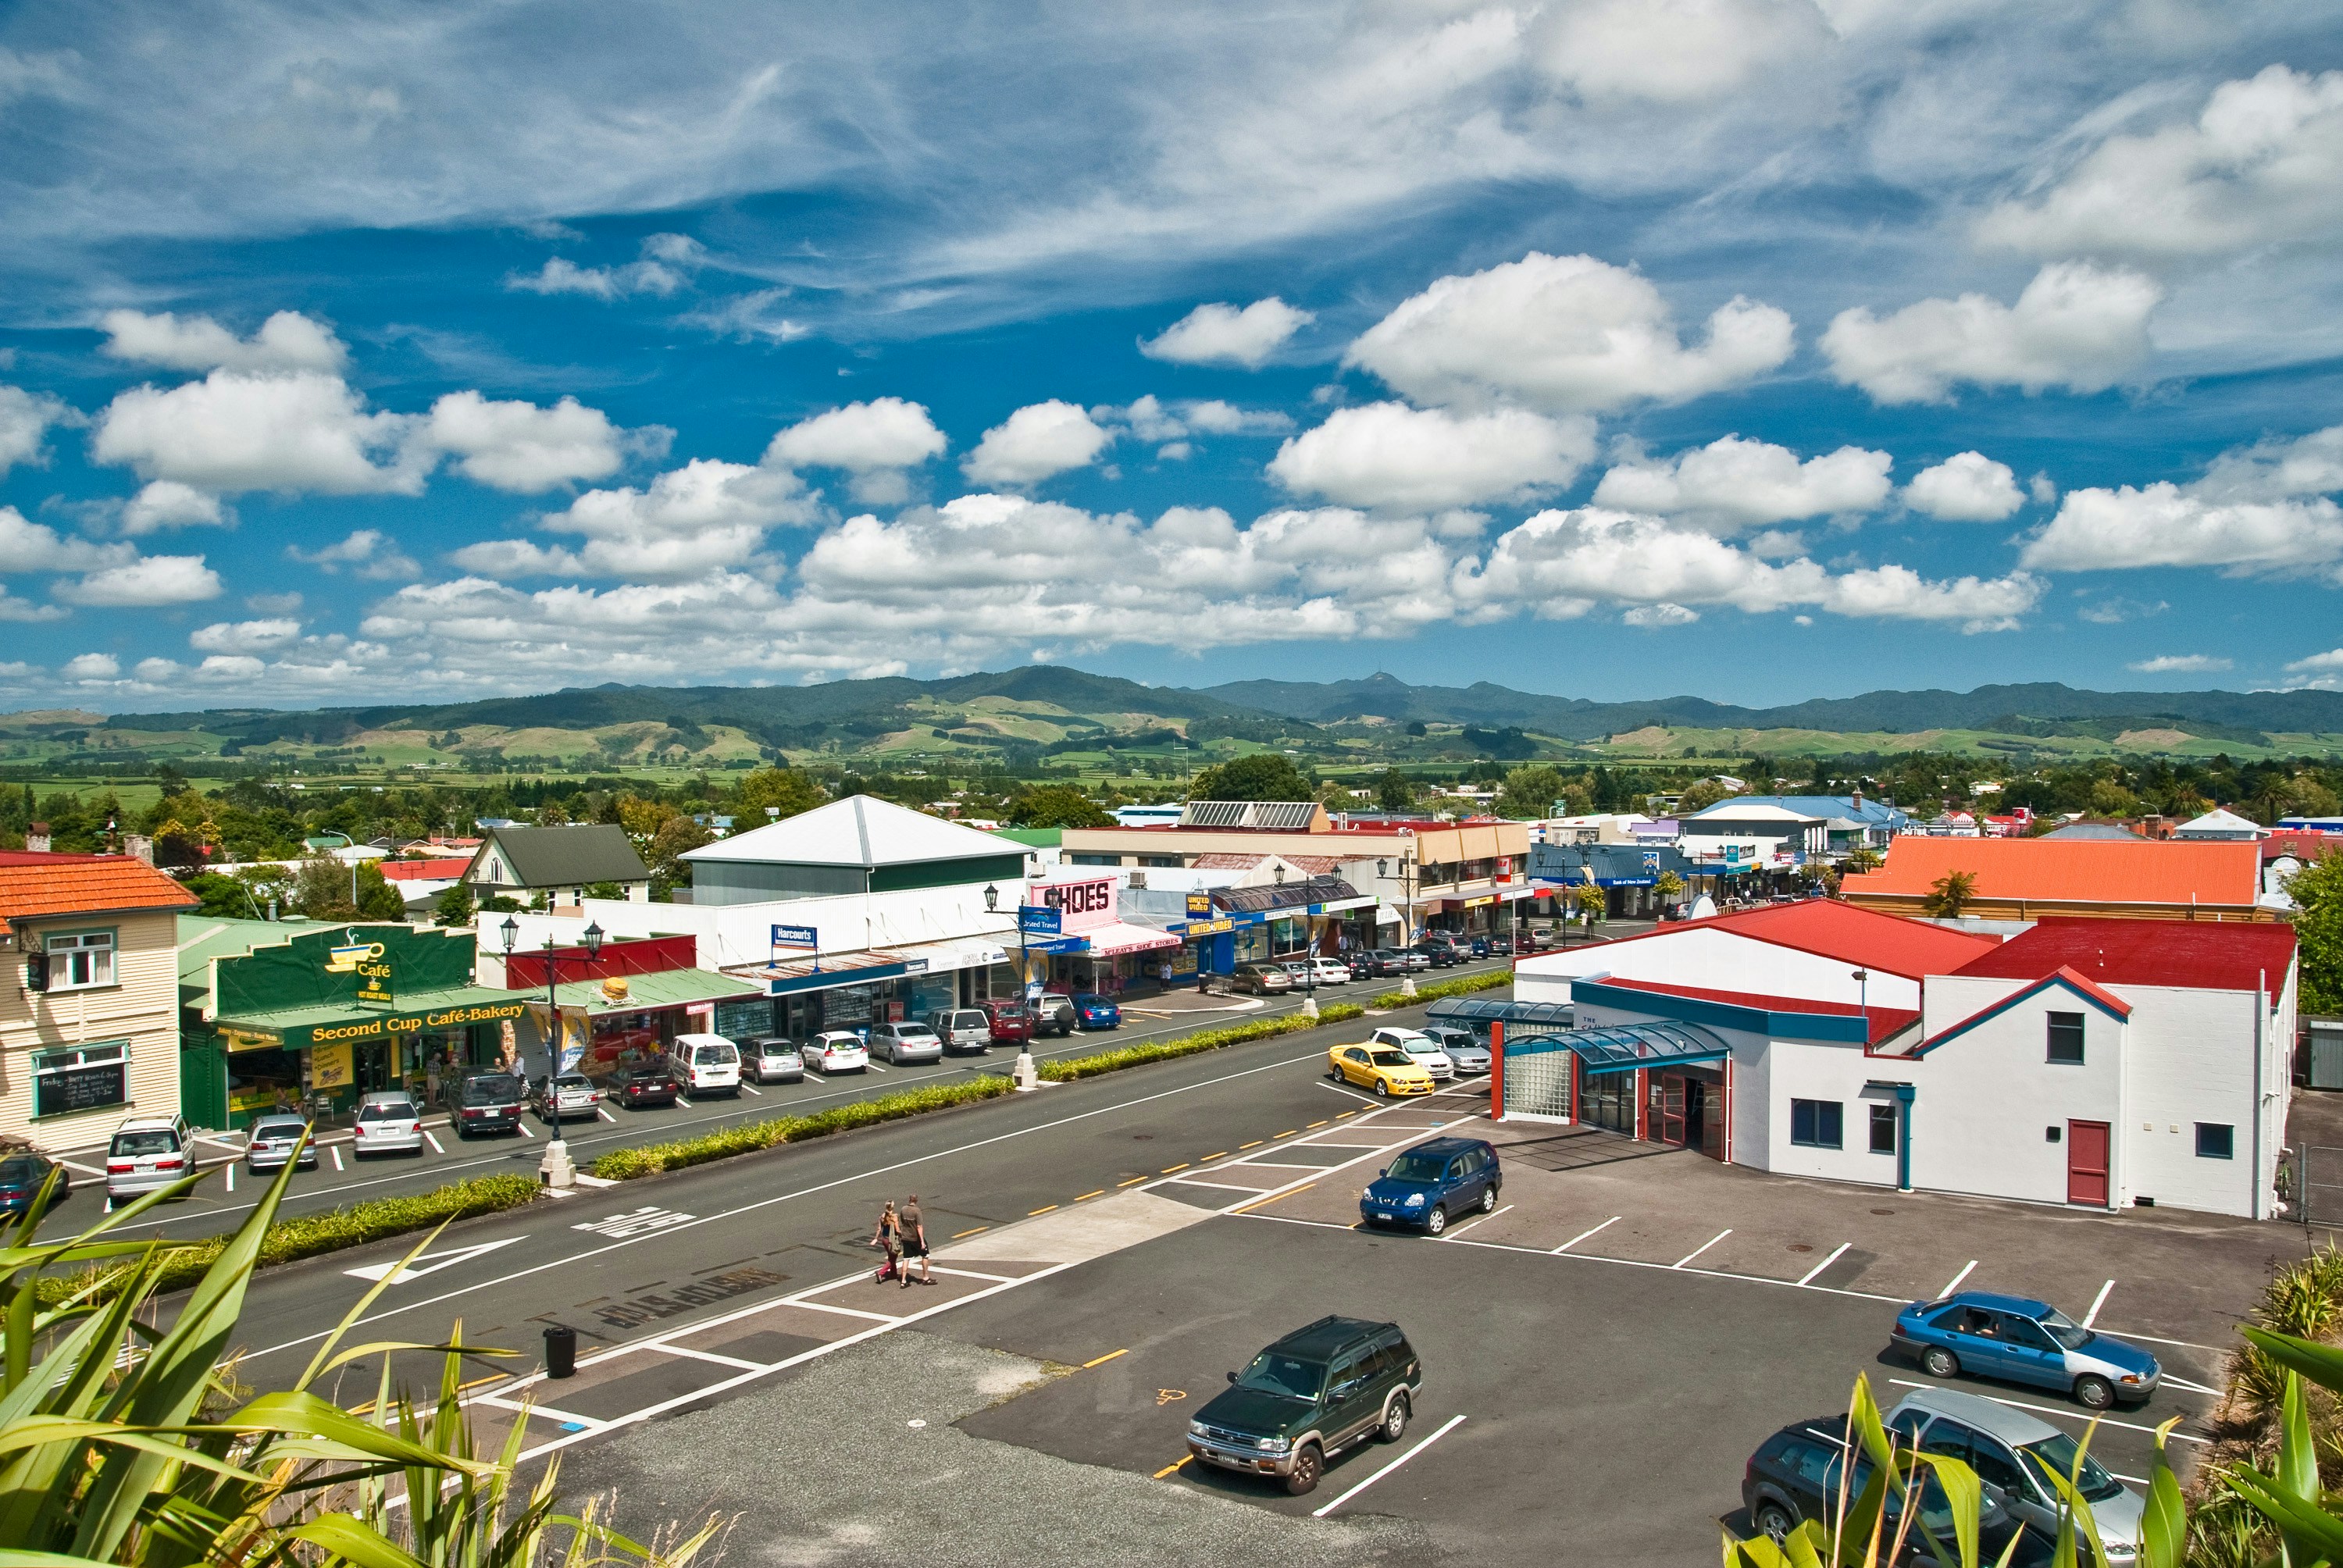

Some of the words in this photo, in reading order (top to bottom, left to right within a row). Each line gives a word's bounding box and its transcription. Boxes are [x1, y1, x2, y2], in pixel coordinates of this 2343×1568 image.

[1189, 923, 1211, 935] UNITED
[1213, 920, 1232, 931] VIDEO
[777, 928, 811, 940] Harcourts
[1155, 938, 1179, 947] STORES
[358, 964, 390, 977] Café
[313, 1021, 381, 1042] Second
[387, 1018, 423, 1032] Cup
[426, 1004, 525, 1026] Café-Bakery
[317, 1052, 334, 1062] Lunch
[317, 1058, 340, 1070] Dinners
